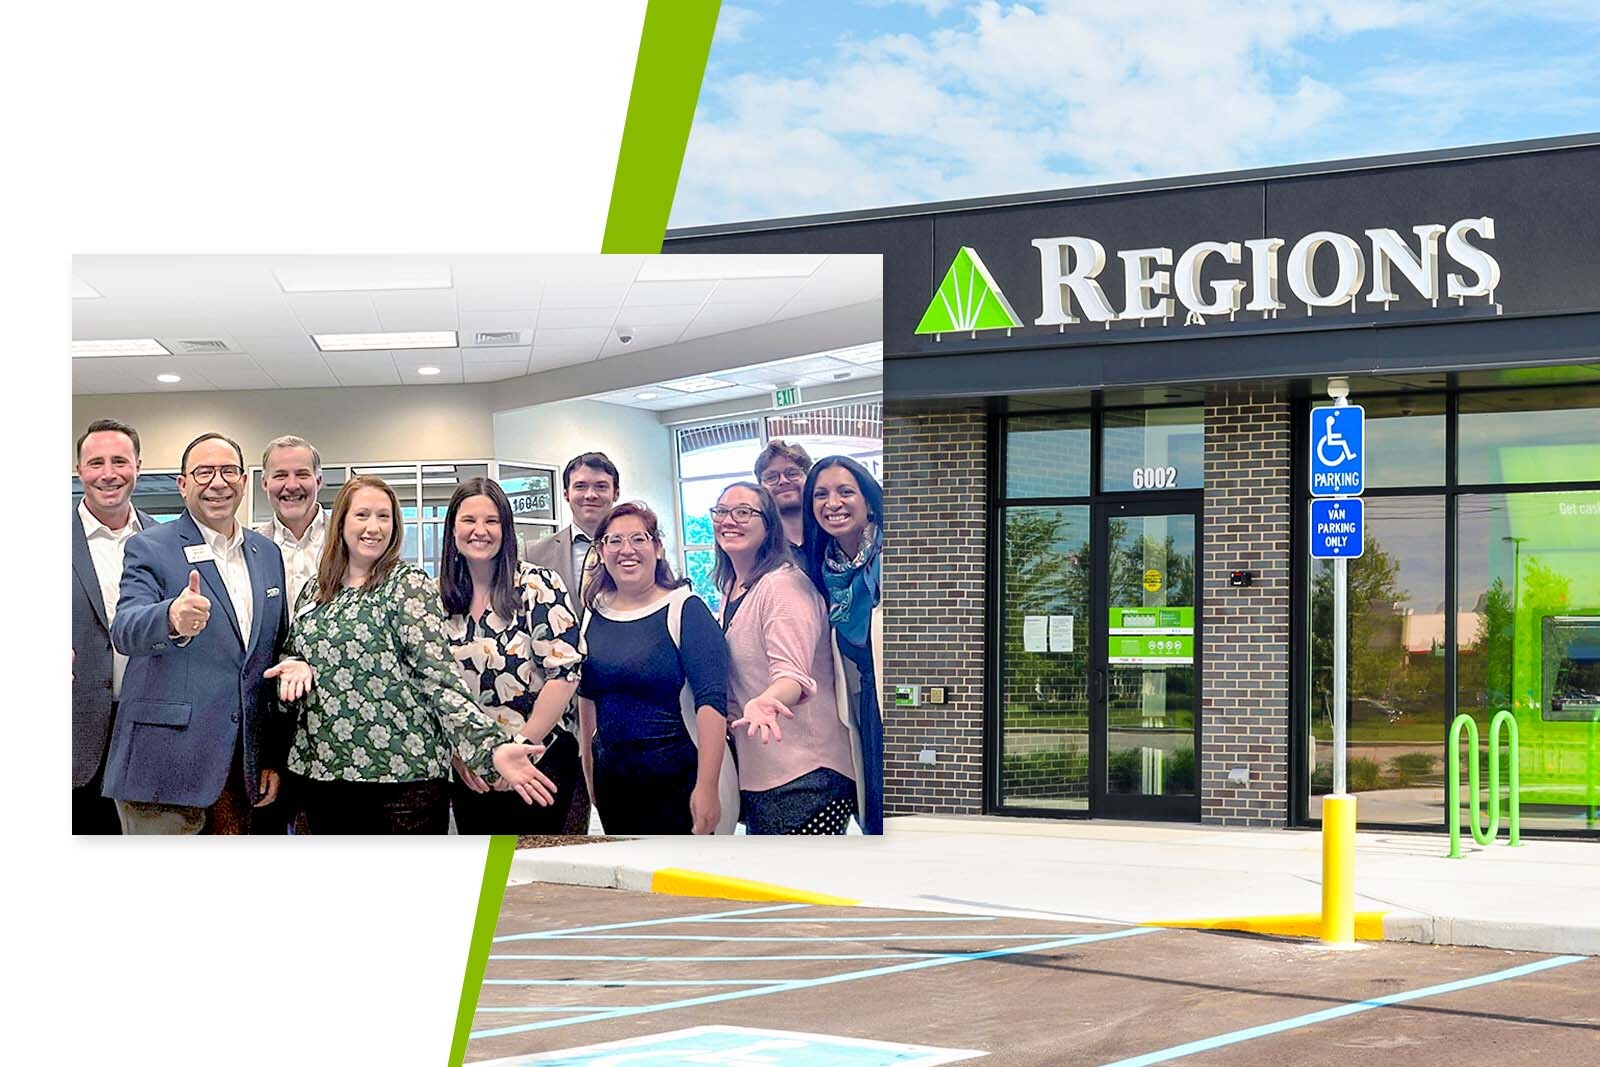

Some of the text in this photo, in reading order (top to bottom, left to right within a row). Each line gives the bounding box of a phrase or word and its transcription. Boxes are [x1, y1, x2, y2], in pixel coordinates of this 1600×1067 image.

[1031, 216, 1501, 327] REGIONS
[776, 388, 795, 407] EXIT
[1132, 466, 1177, 489] 6002
[1314, 471, 1360, 487] PARKING
[1328, 509, 1346, 520] VAN
[1559, 502, 1577, 515] Get
[1317, 522, 1356, 534] PARKING
[1325, 536, 1348, 547] ONLY
